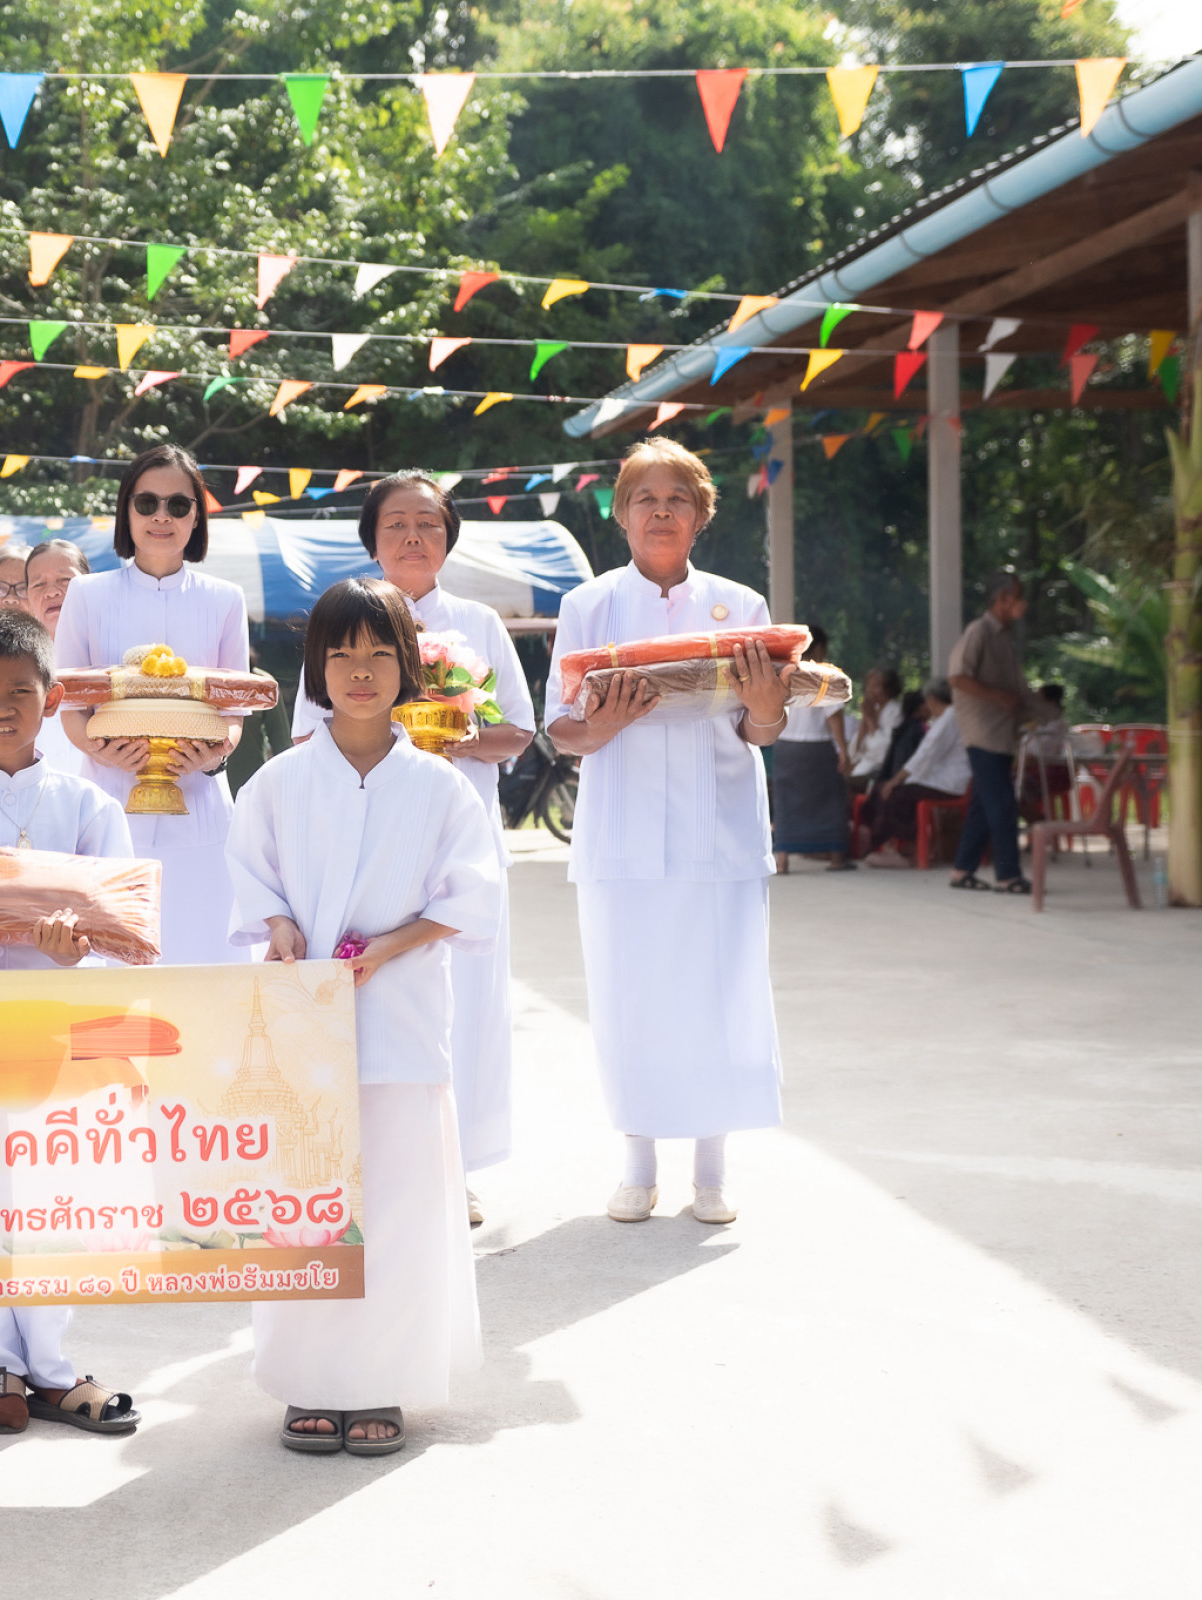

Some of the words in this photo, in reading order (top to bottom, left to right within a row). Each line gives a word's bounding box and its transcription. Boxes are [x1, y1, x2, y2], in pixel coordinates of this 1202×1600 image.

[180, 1187, 344, 1227] ๒๕๖๘
[79, 1277, 111, 1295] ๘๑
[122, 1268, 138, 1293] ปี
[148, 1263, 338, 1292] หลวงพ่อธัมมชโย
